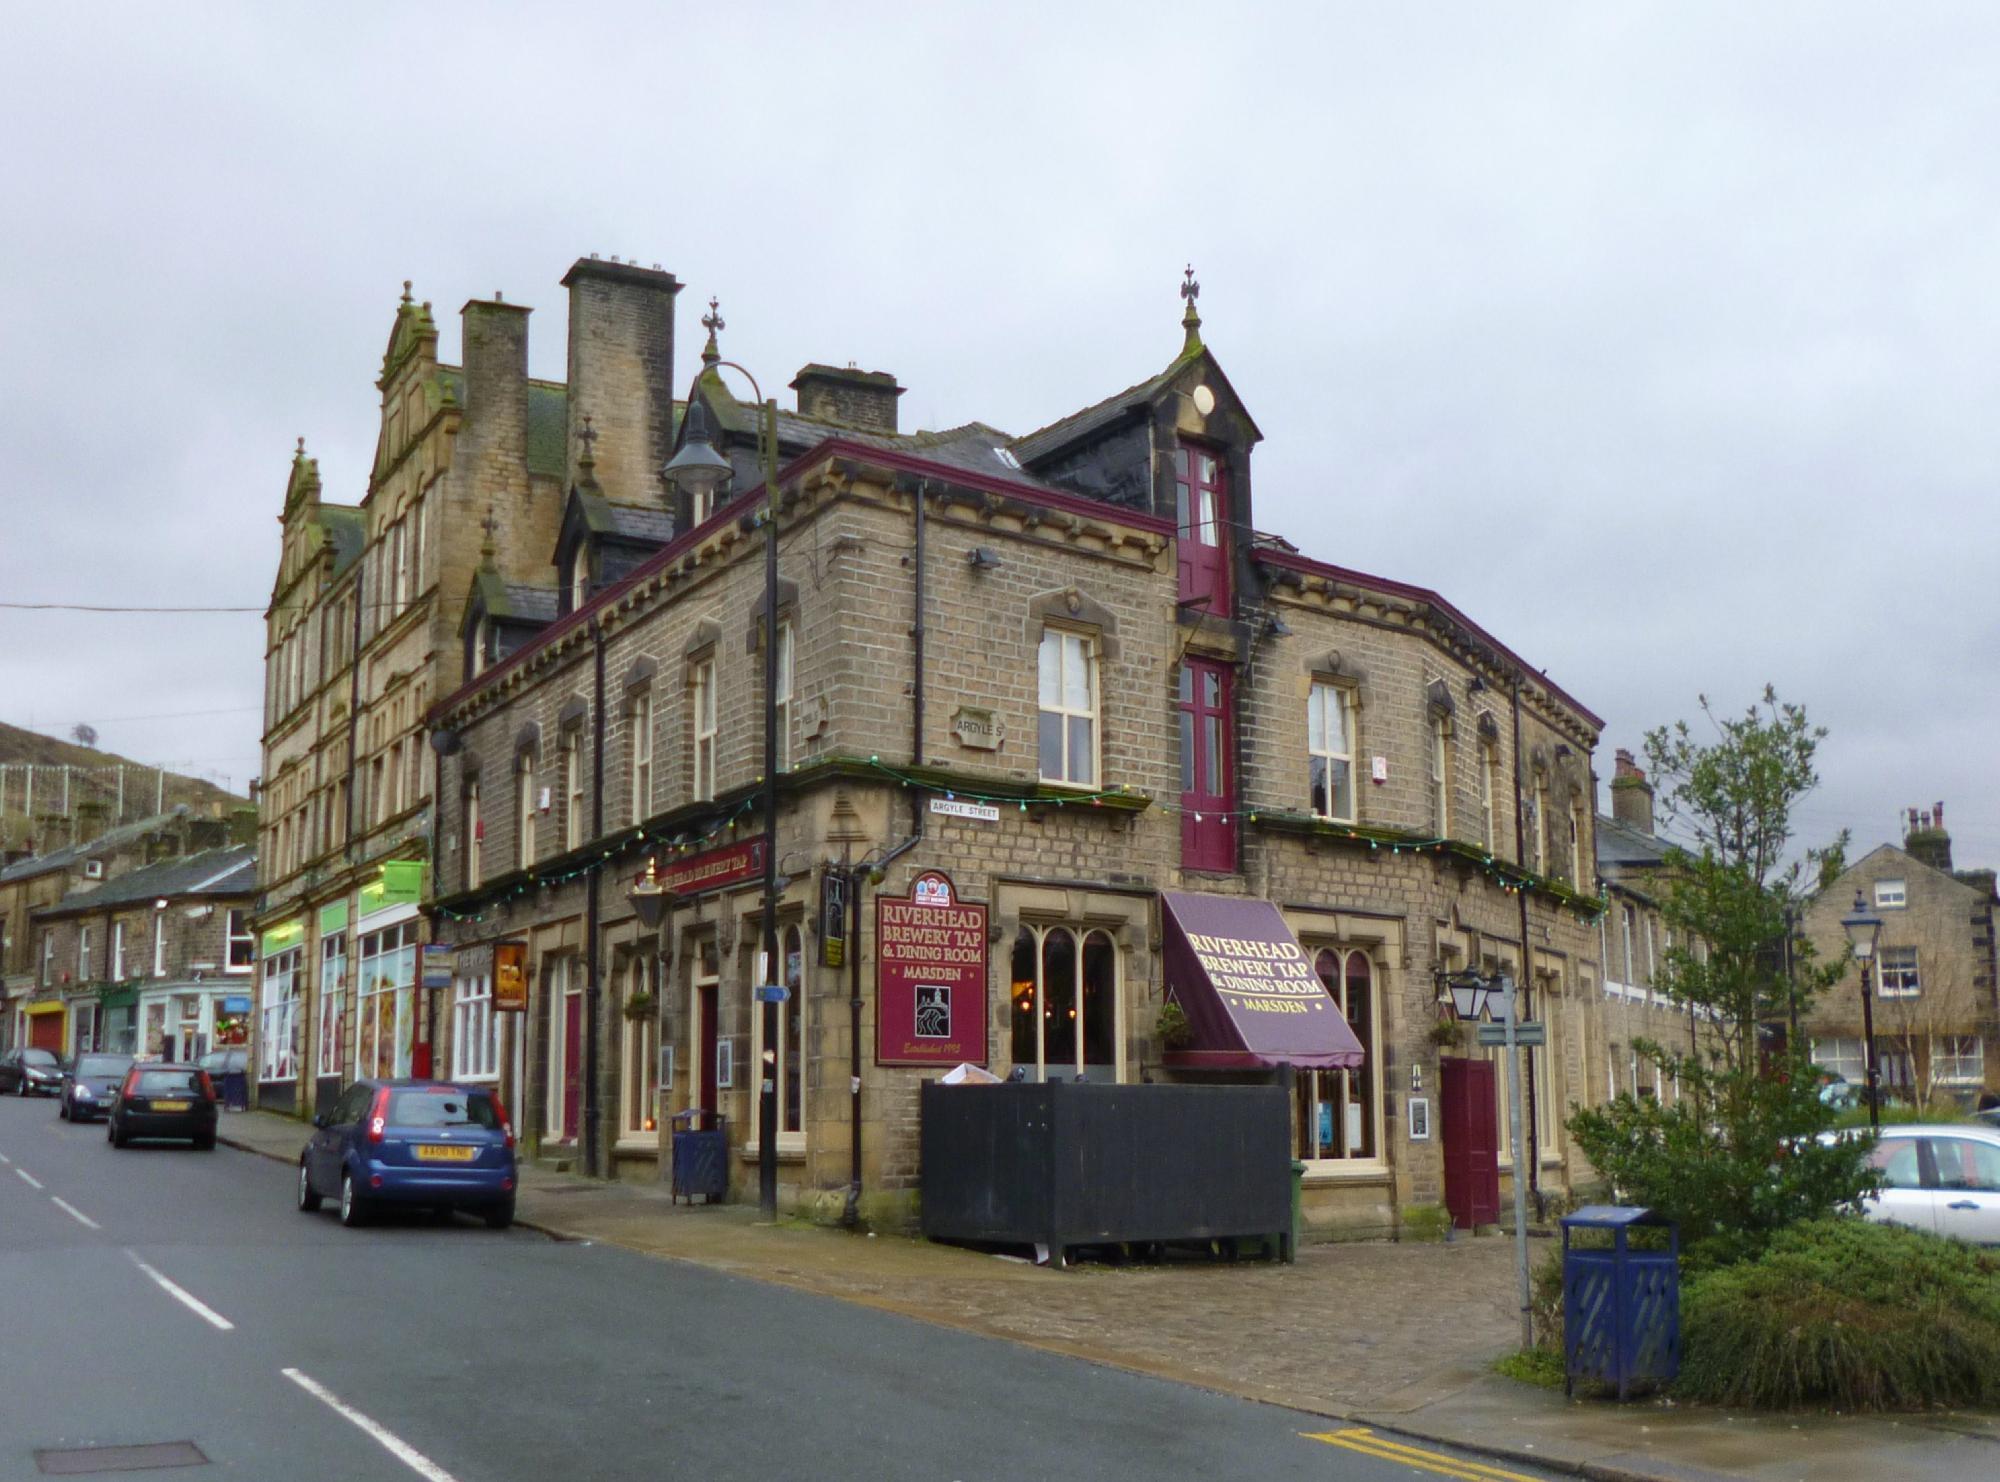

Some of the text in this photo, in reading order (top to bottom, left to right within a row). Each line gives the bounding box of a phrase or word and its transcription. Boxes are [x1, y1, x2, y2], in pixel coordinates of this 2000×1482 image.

[957, 720, 993, 736] ARGYLE
[933, 801, 996, 818] ARGYLE STREET
[882, 905, 982, 929] RIVERHEAD
[882, 925, 982, 947] BREWERY TAP
[882, 944, 982, 963] & DINING ROOM
[1186, 932, 1300, 960] RIVERHEAD
[903, 966, 961, 981] MARSDEN
[1198, 954, 1308, 978] BREWERY TAP
[1210, 973, 1322, 993] & DINING ROOM
[1243, 998, 1308, 1013] MARSDEN
